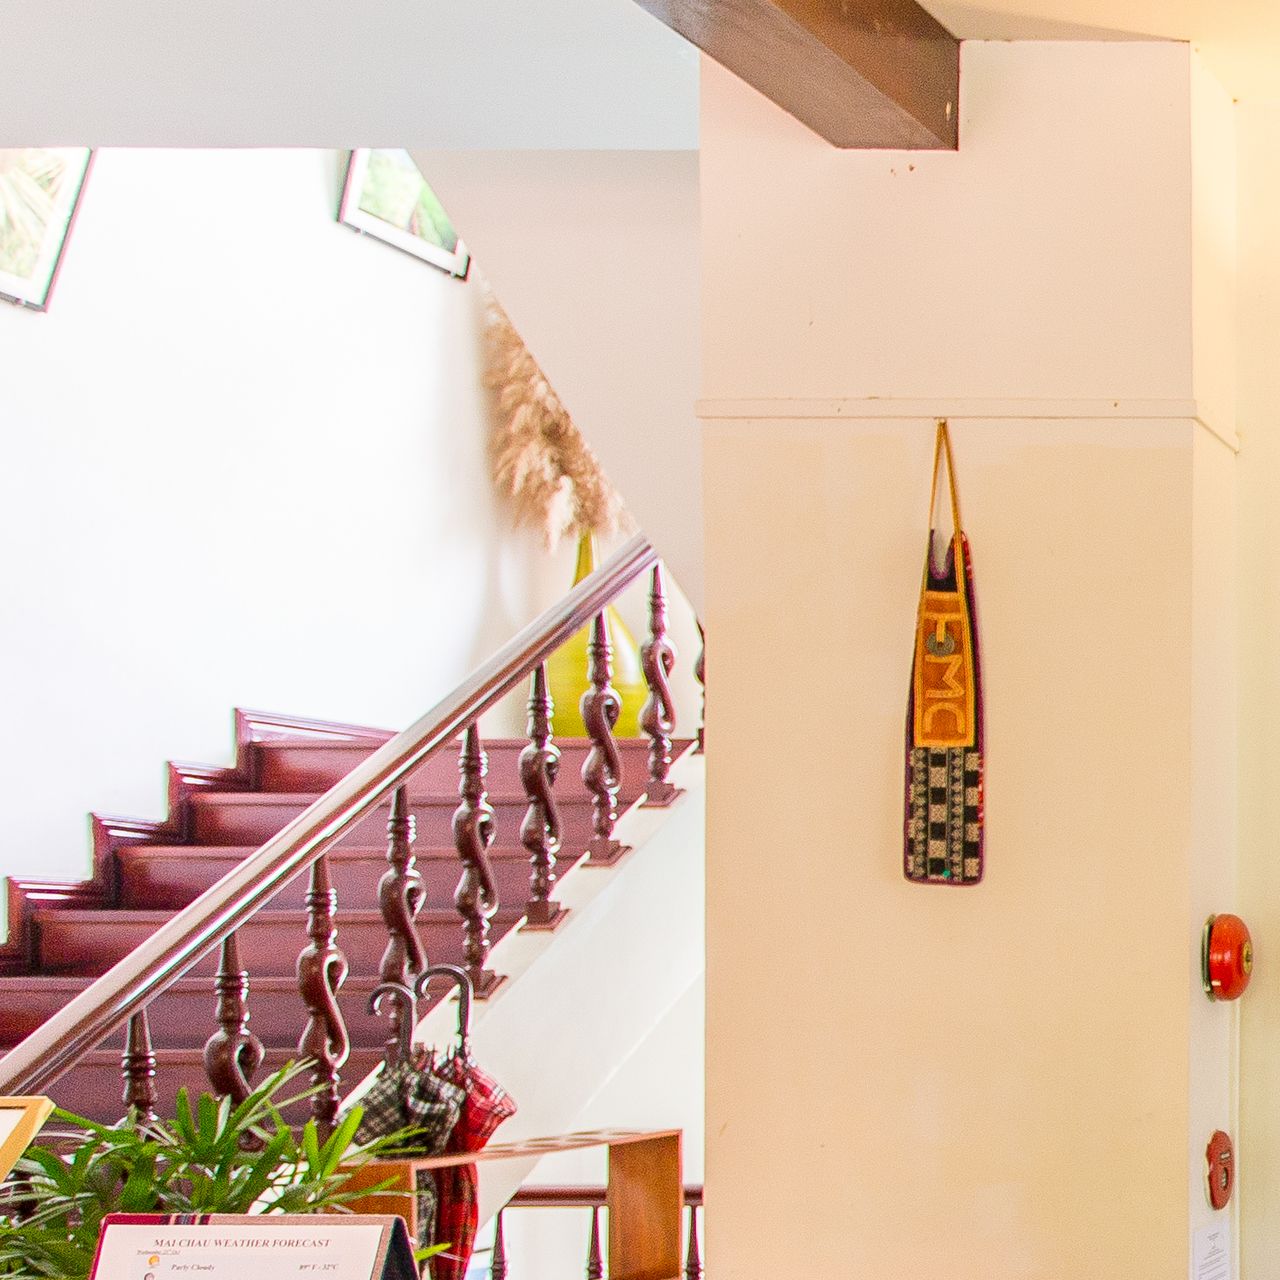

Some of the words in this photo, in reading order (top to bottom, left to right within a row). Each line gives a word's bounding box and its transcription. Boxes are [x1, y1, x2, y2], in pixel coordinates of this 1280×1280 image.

[154, 1239, 176, 1248] MAI
[178, 1239, 211, 1248] CHAU
[214, 1239, 270, 1248] WEATHER
[272, 1239, 332, 1248] FORECAST
[191, 1263, 215, 1272] Cloudy
